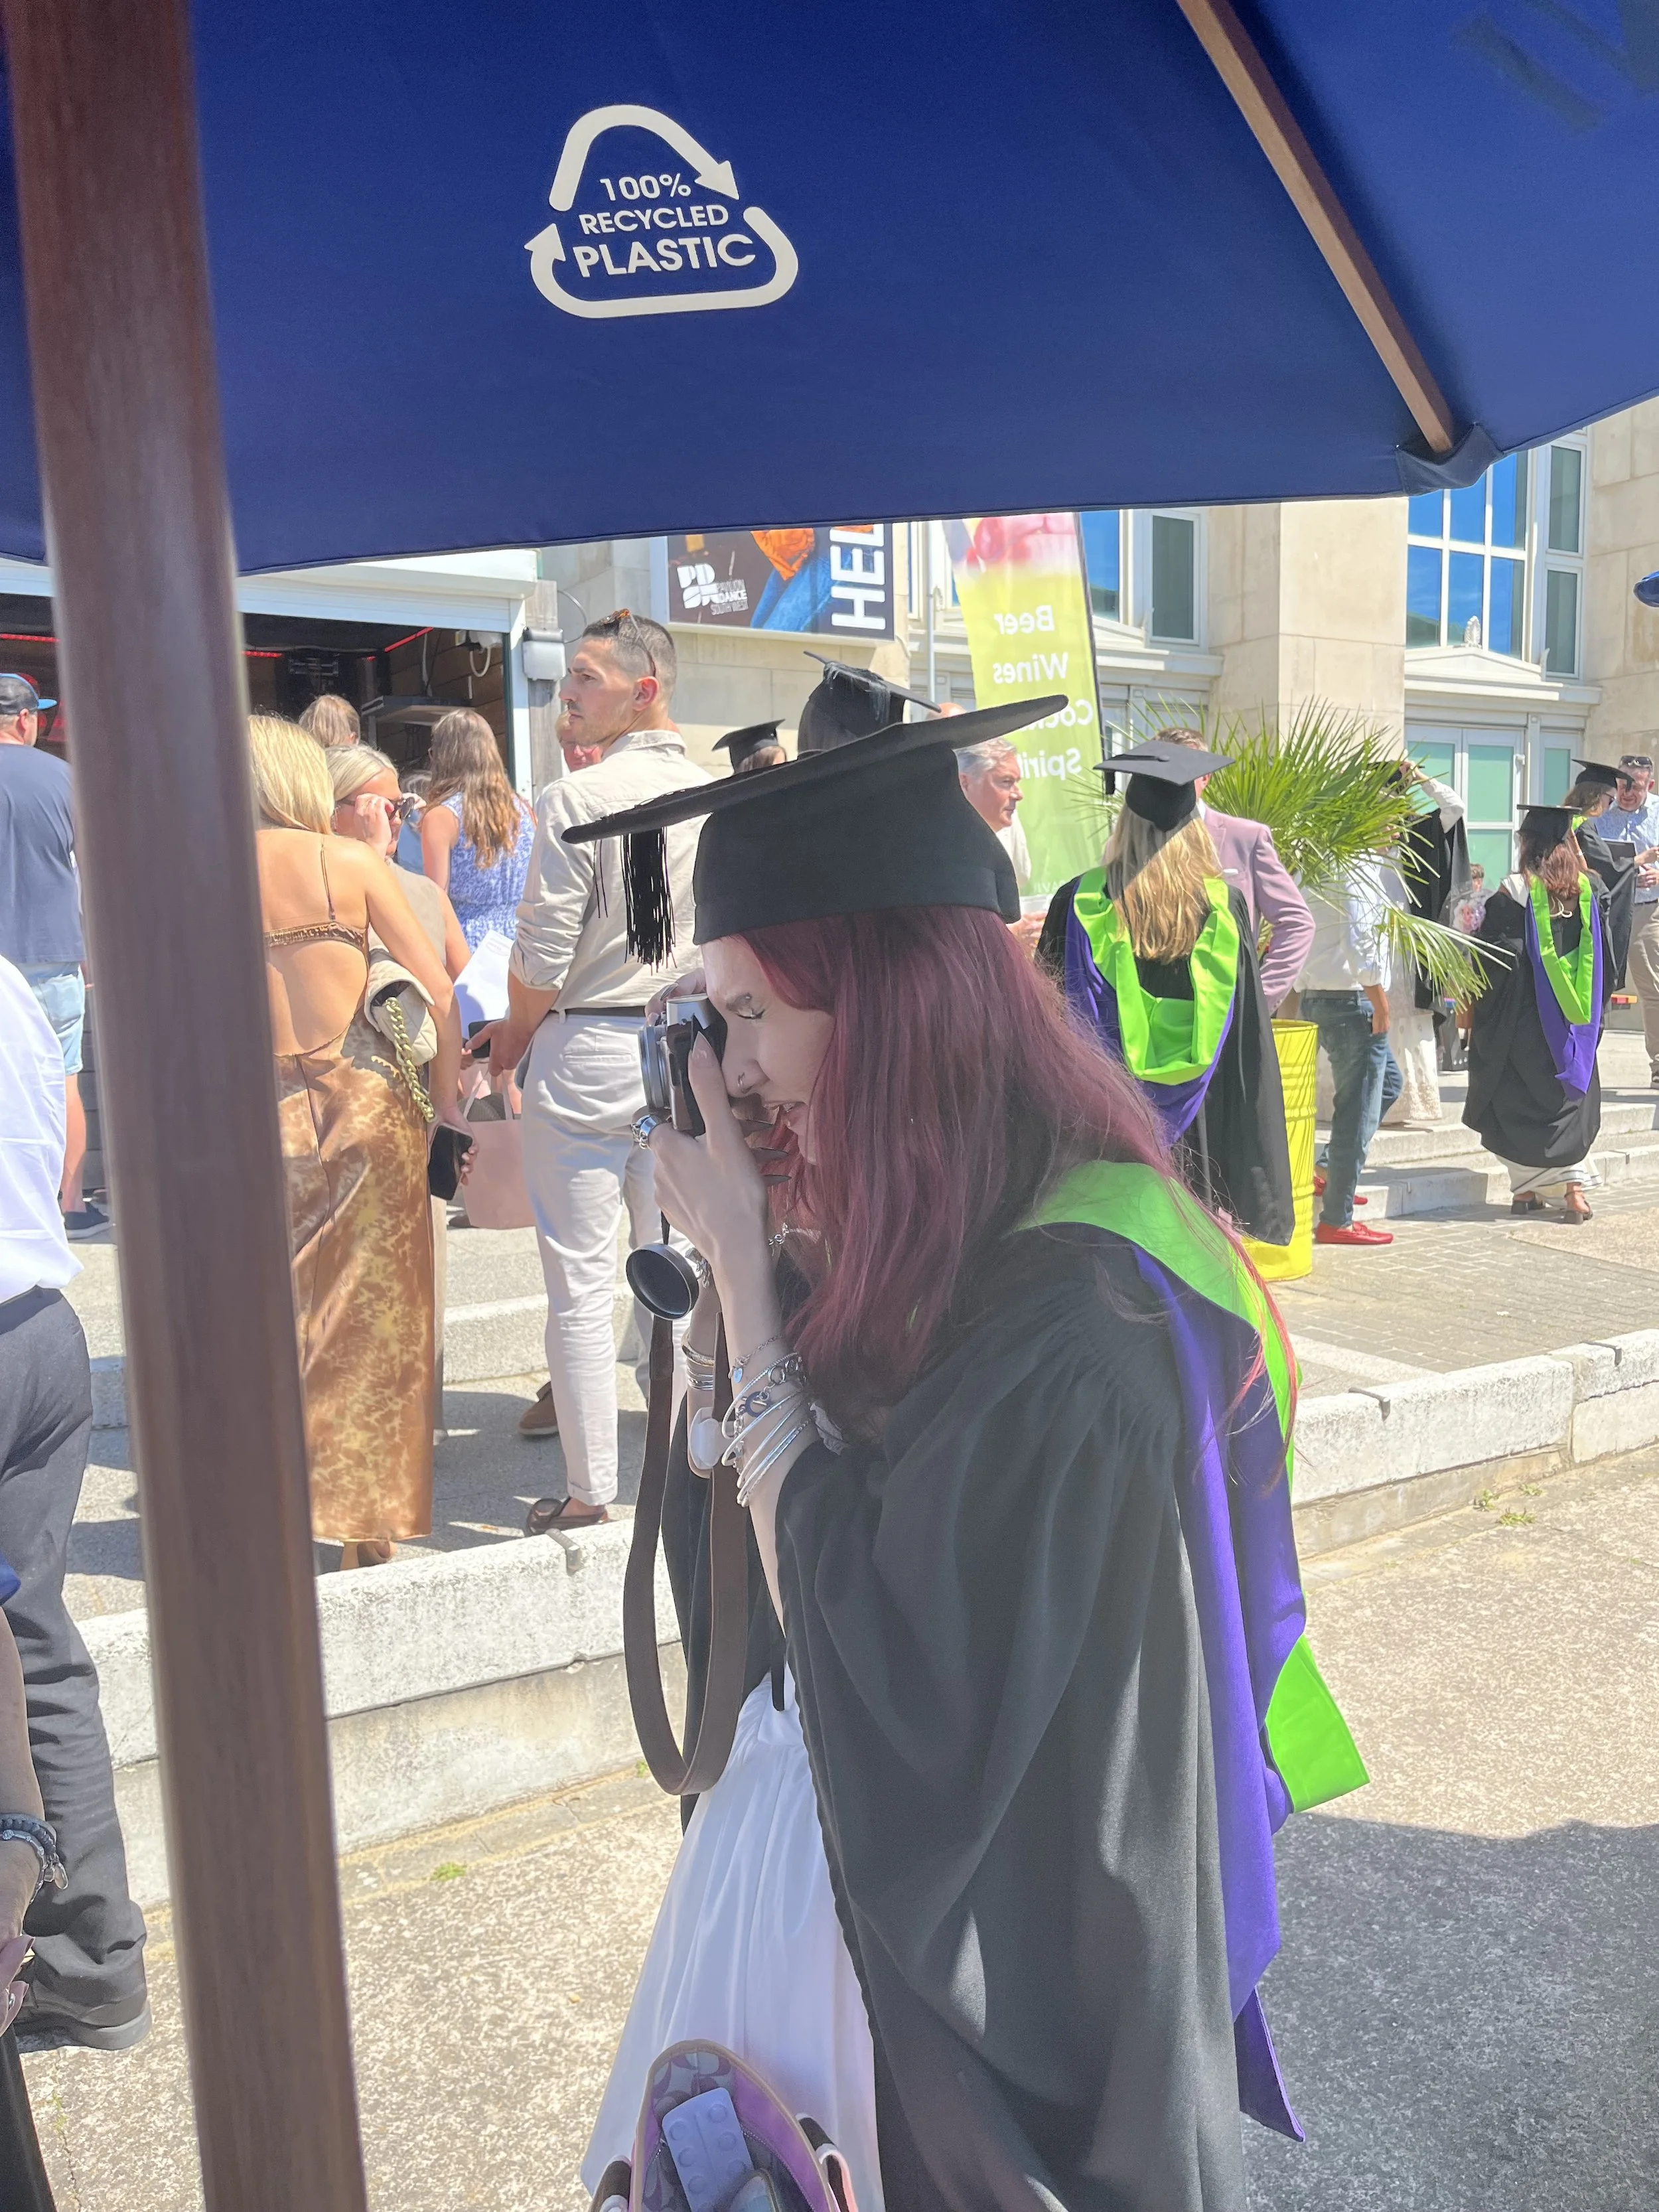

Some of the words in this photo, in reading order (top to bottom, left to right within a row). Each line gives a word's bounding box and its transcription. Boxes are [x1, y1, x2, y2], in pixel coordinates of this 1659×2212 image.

[599, 173, 691, 201] 100%
[579, 204, 729, 235] RECYCLED
[573, 234, 756, 277] PLASTIC
